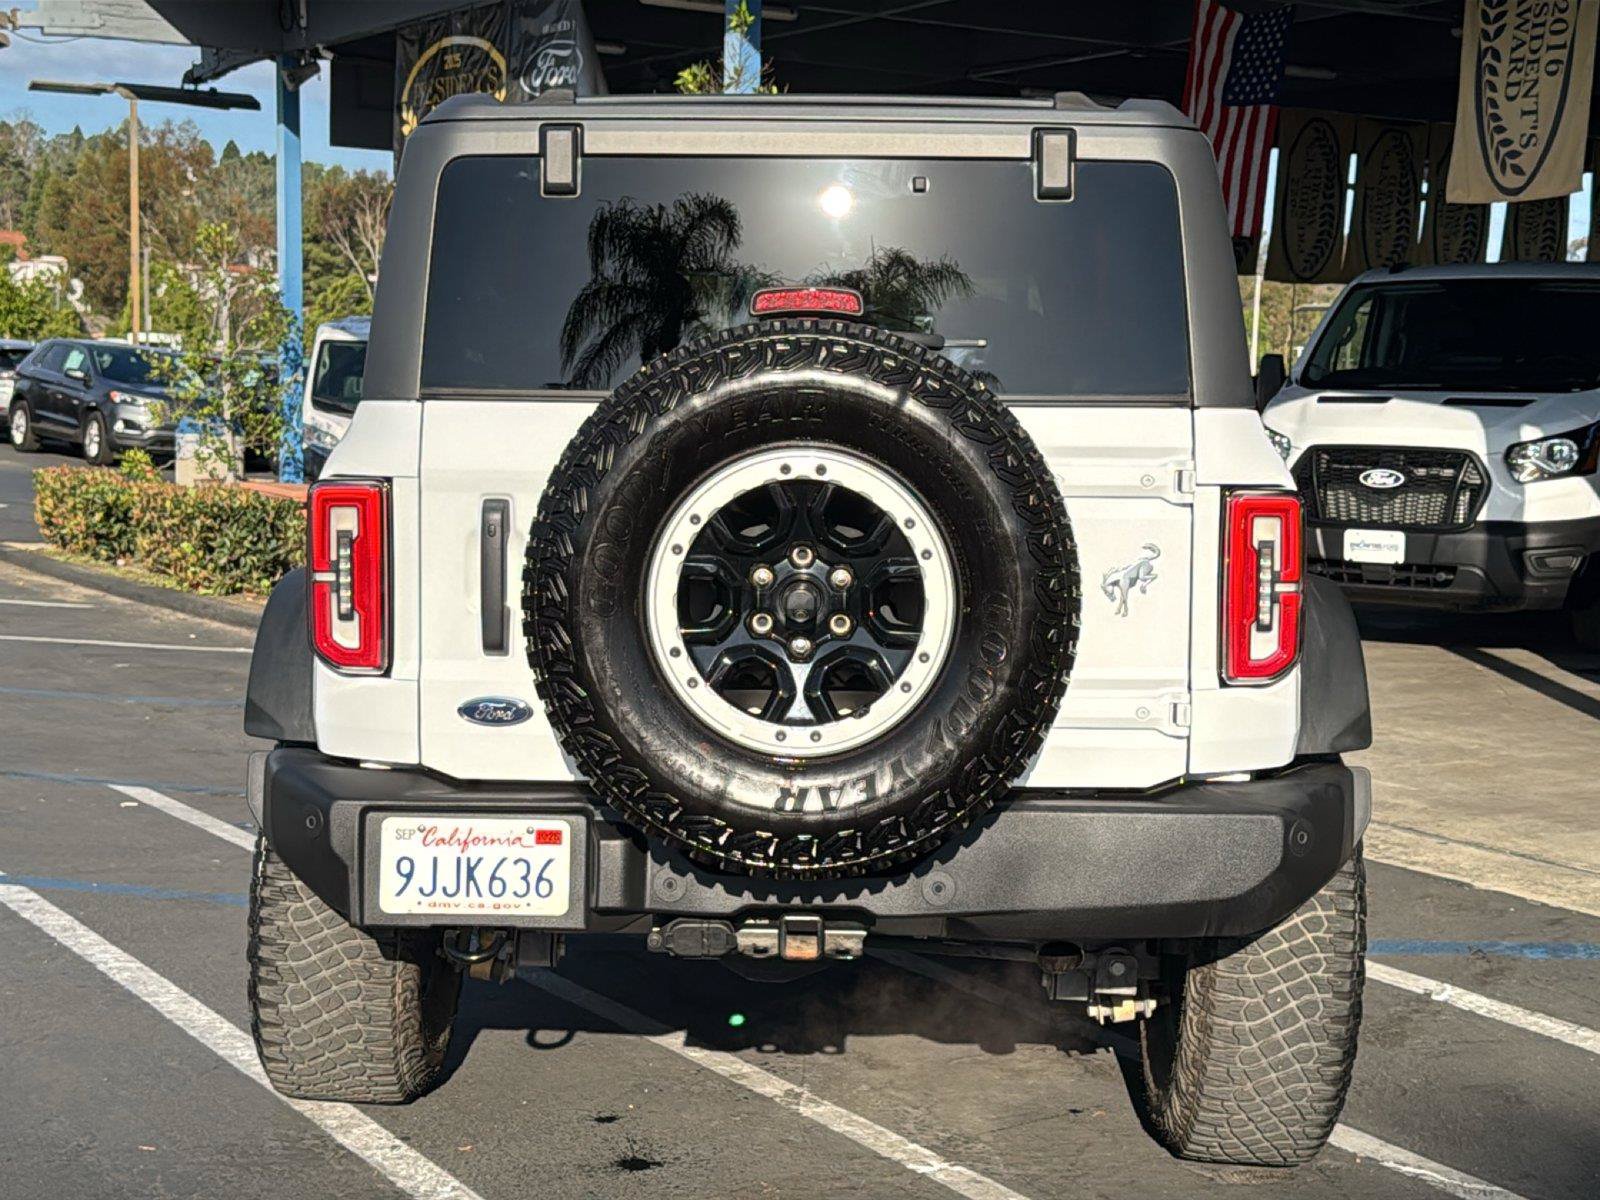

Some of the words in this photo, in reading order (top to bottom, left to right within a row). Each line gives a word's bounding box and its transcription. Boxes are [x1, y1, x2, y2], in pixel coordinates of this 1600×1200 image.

[1545, 0, 1569, 77] 2016
[474, 702, 516, 721] Ford
[395, 828, 416, 841] SEP
[422, 826, 534, 853] California
[394, 856, 555, 898] 9JJK636
[427, 900, 522, 910] dmv.ca.gov
